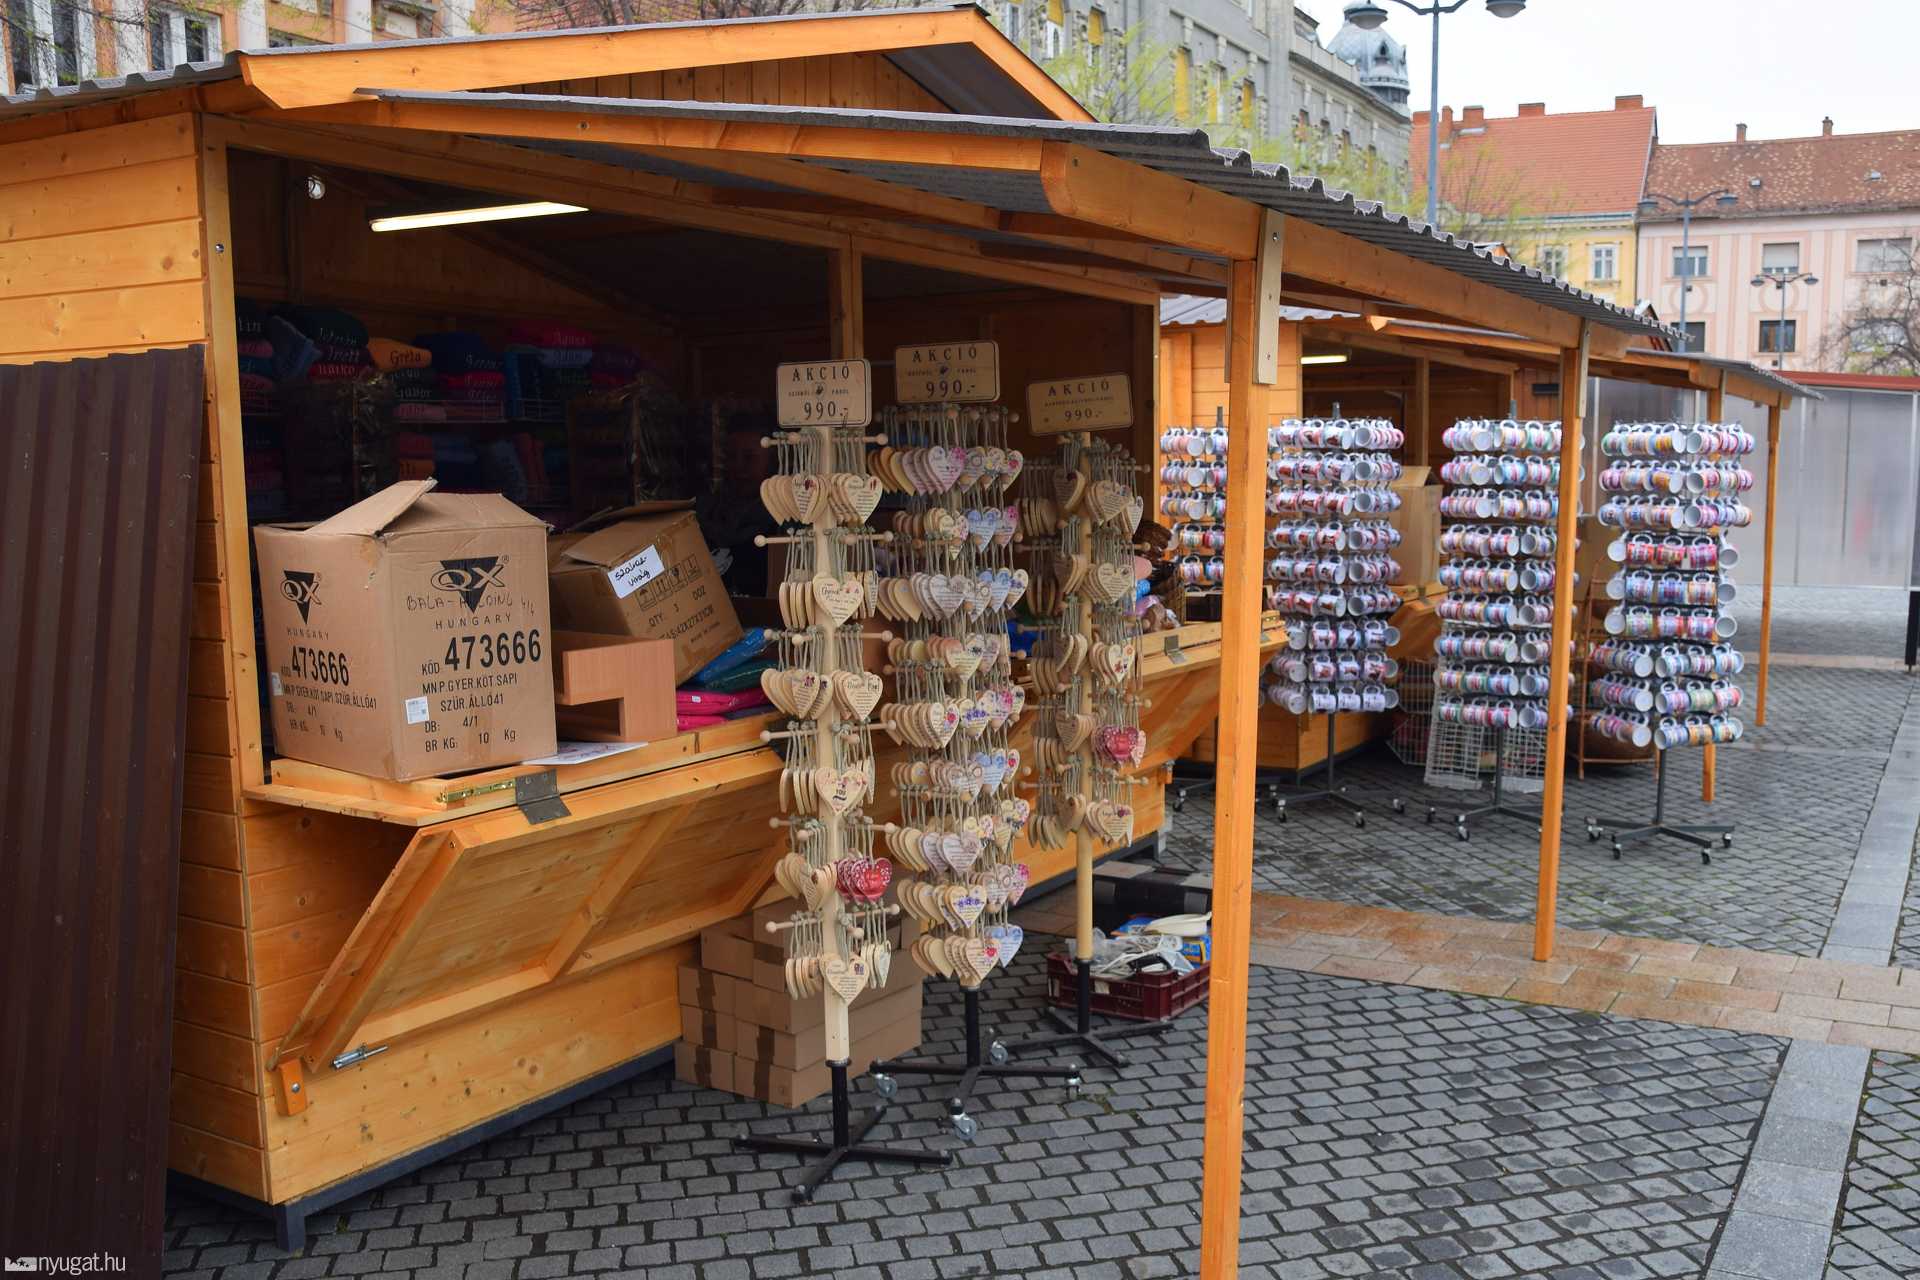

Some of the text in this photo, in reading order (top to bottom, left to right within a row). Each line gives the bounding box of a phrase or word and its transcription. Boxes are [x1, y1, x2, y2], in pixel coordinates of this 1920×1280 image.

[913, 344, 977, 362] AKCIÓ
[792, 361, 849, 381] AKCIÓ
[926, 380, 976, 398] 990.-
[1048, 379, 1110, 397] AKCIÓ
[430, 564, 506, 592] QX
[280, 580, 322, 605] QX
[435, 613, 512, 630] HUNGARY
[444, 629, 542, 671] 473666
[291, 645, 350, 687] 473666
[479, 732, 490, 745] 10
[504, 728, 516, 742] Kg
